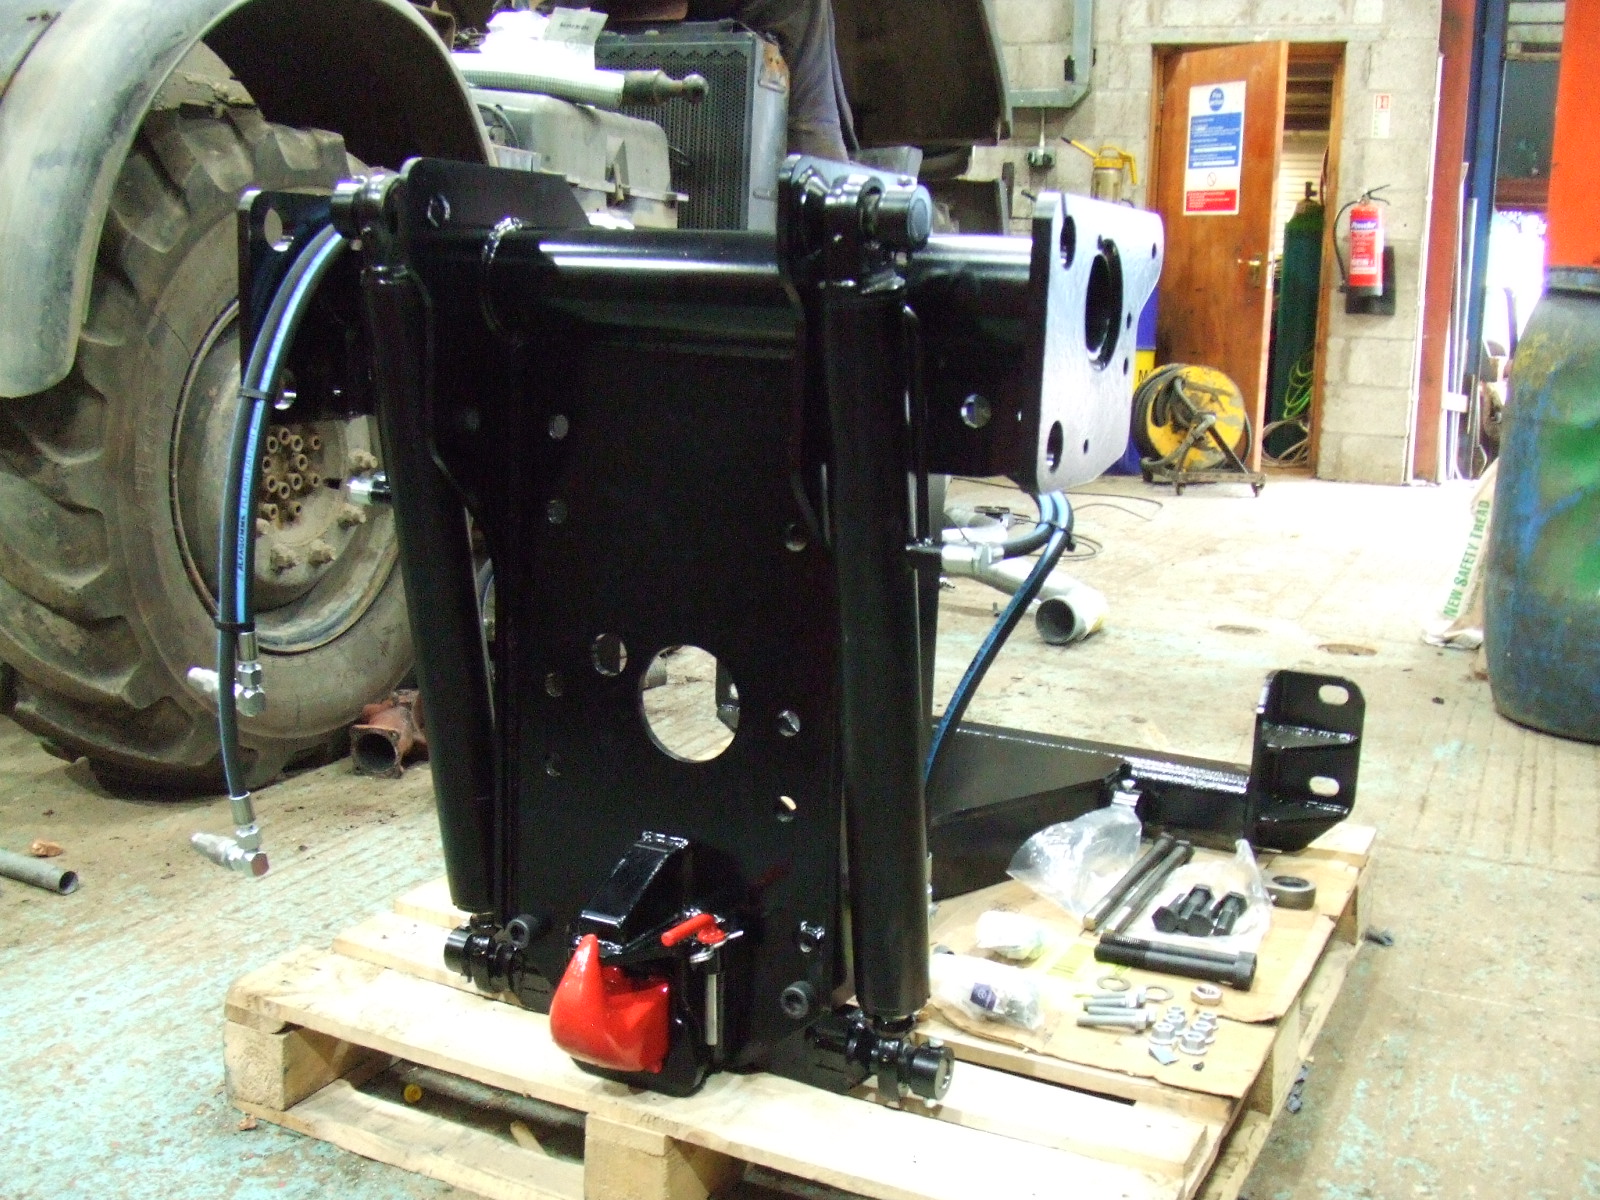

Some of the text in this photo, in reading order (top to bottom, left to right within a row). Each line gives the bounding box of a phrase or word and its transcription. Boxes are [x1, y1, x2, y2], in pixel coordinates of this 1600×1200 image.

[1443, 588, 1463, 618] NEW
[1454, 542, 1480, 588] SAFETY
[1469, 500, 1491, 540] TREAD
